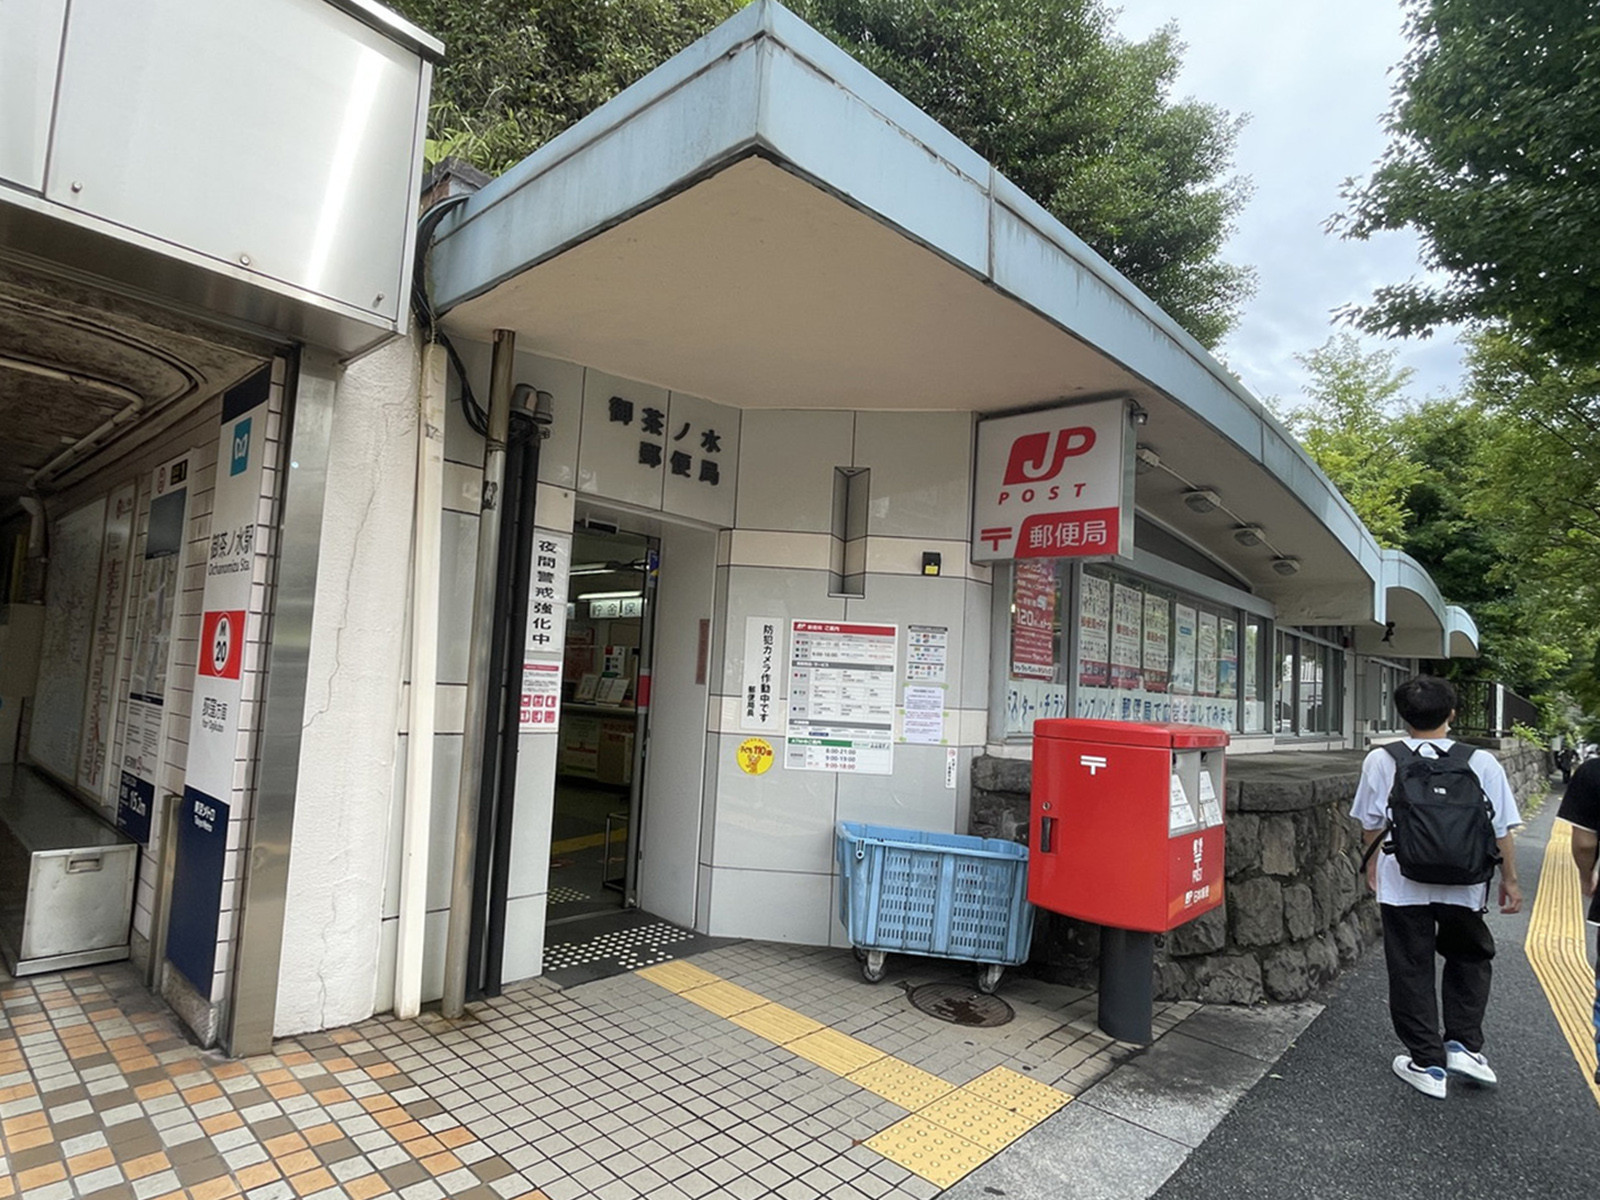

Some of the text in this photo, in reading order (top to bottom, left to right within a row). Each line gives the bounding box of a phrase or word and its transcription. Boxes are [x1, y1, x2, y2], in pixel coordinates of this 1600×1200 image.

[609, 396, 721, 453] 御茶ノ水
[638, 441, 720, 486] 郵便局
[1003, 426, 1096, 486] JP
[998, 483, 1087, 506] POST
[210, 524, 254, 560] 御茶ノ水駅
[1029, 520, 1107, 549] 郵便局
[533, 540, 557, 645] 夜間警戒強化中
[219, 620, 226, 636] M
[215, 640, 227, 662] 20
[759, 623, 774, 722] 防犯カメラ作動中です
